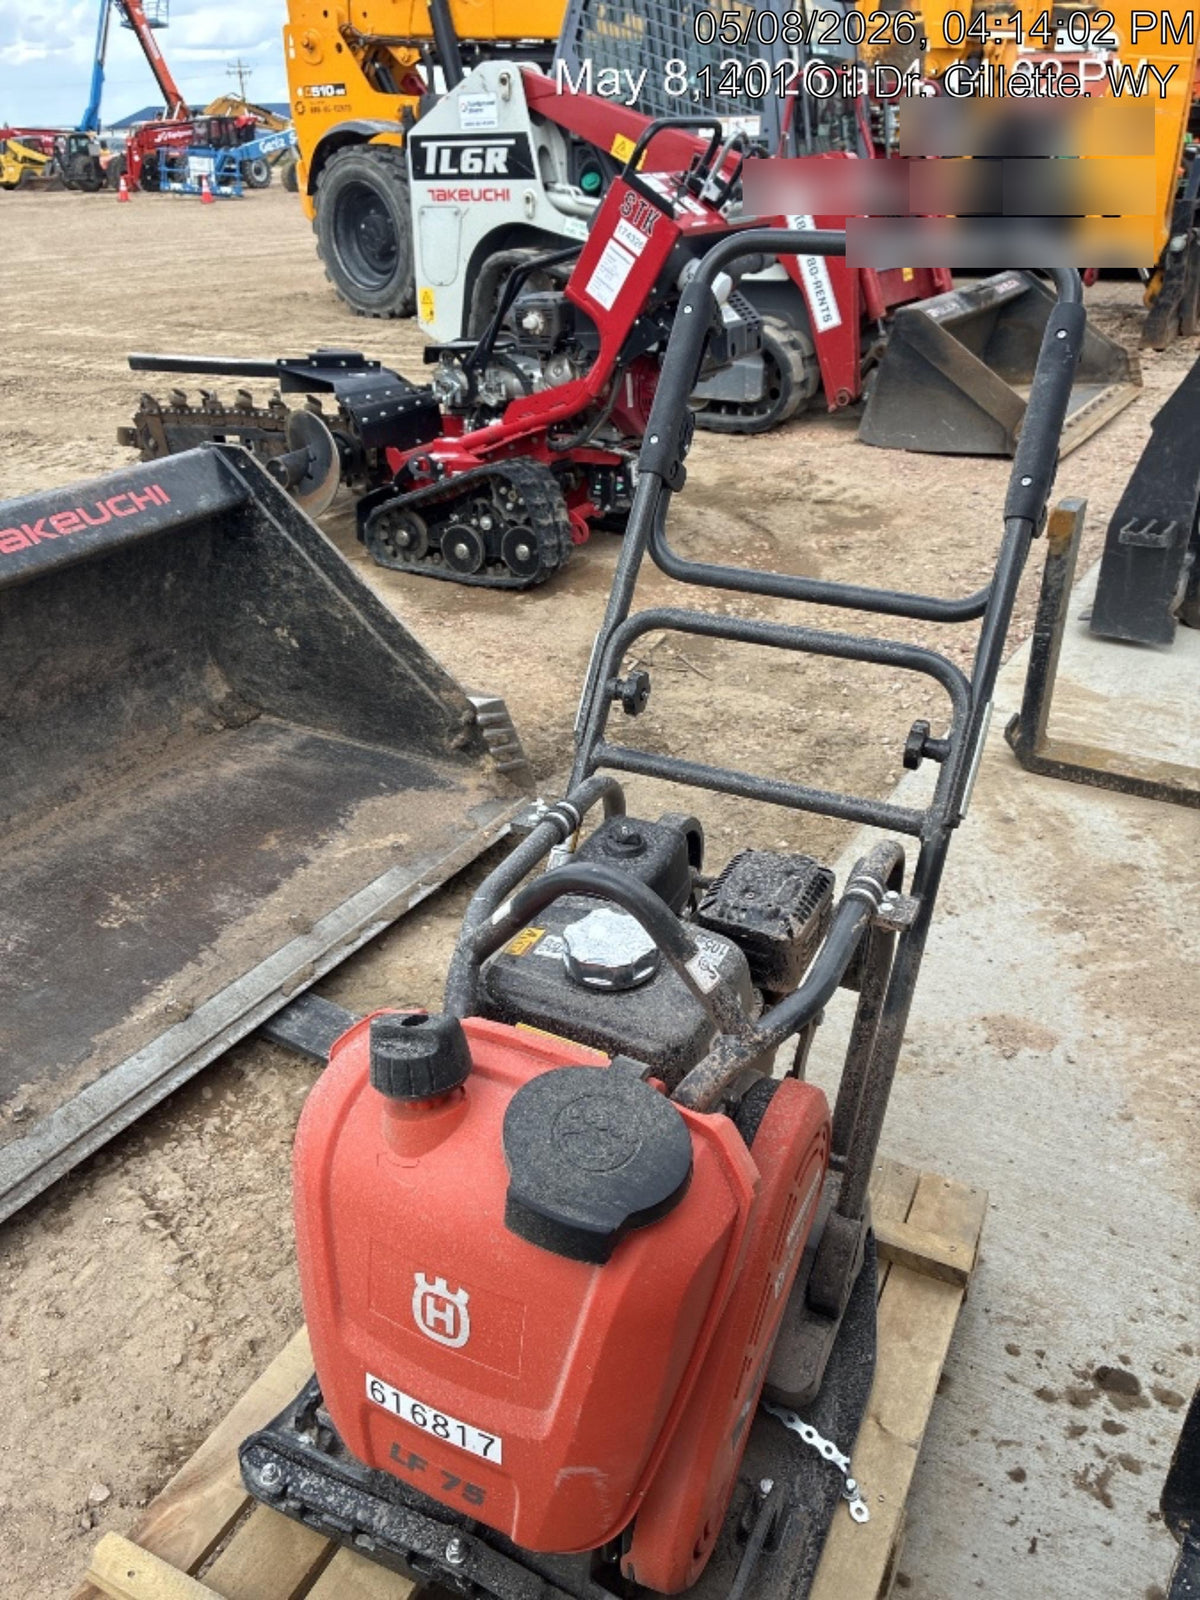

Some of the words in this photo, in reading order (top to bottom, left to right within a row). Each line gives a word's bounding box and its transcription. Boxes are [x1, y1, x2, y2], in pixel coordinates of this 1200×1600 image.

[420, 139, 516, 175] TL6R
[619, 190, 662, 238] STK
[0, 484, 171, 554] AKEUCHI
[370, 1379, 496, 1457] 616817
[389, 1441, 429, 1473] LF
[440, 1469, 487, 1507] 75
